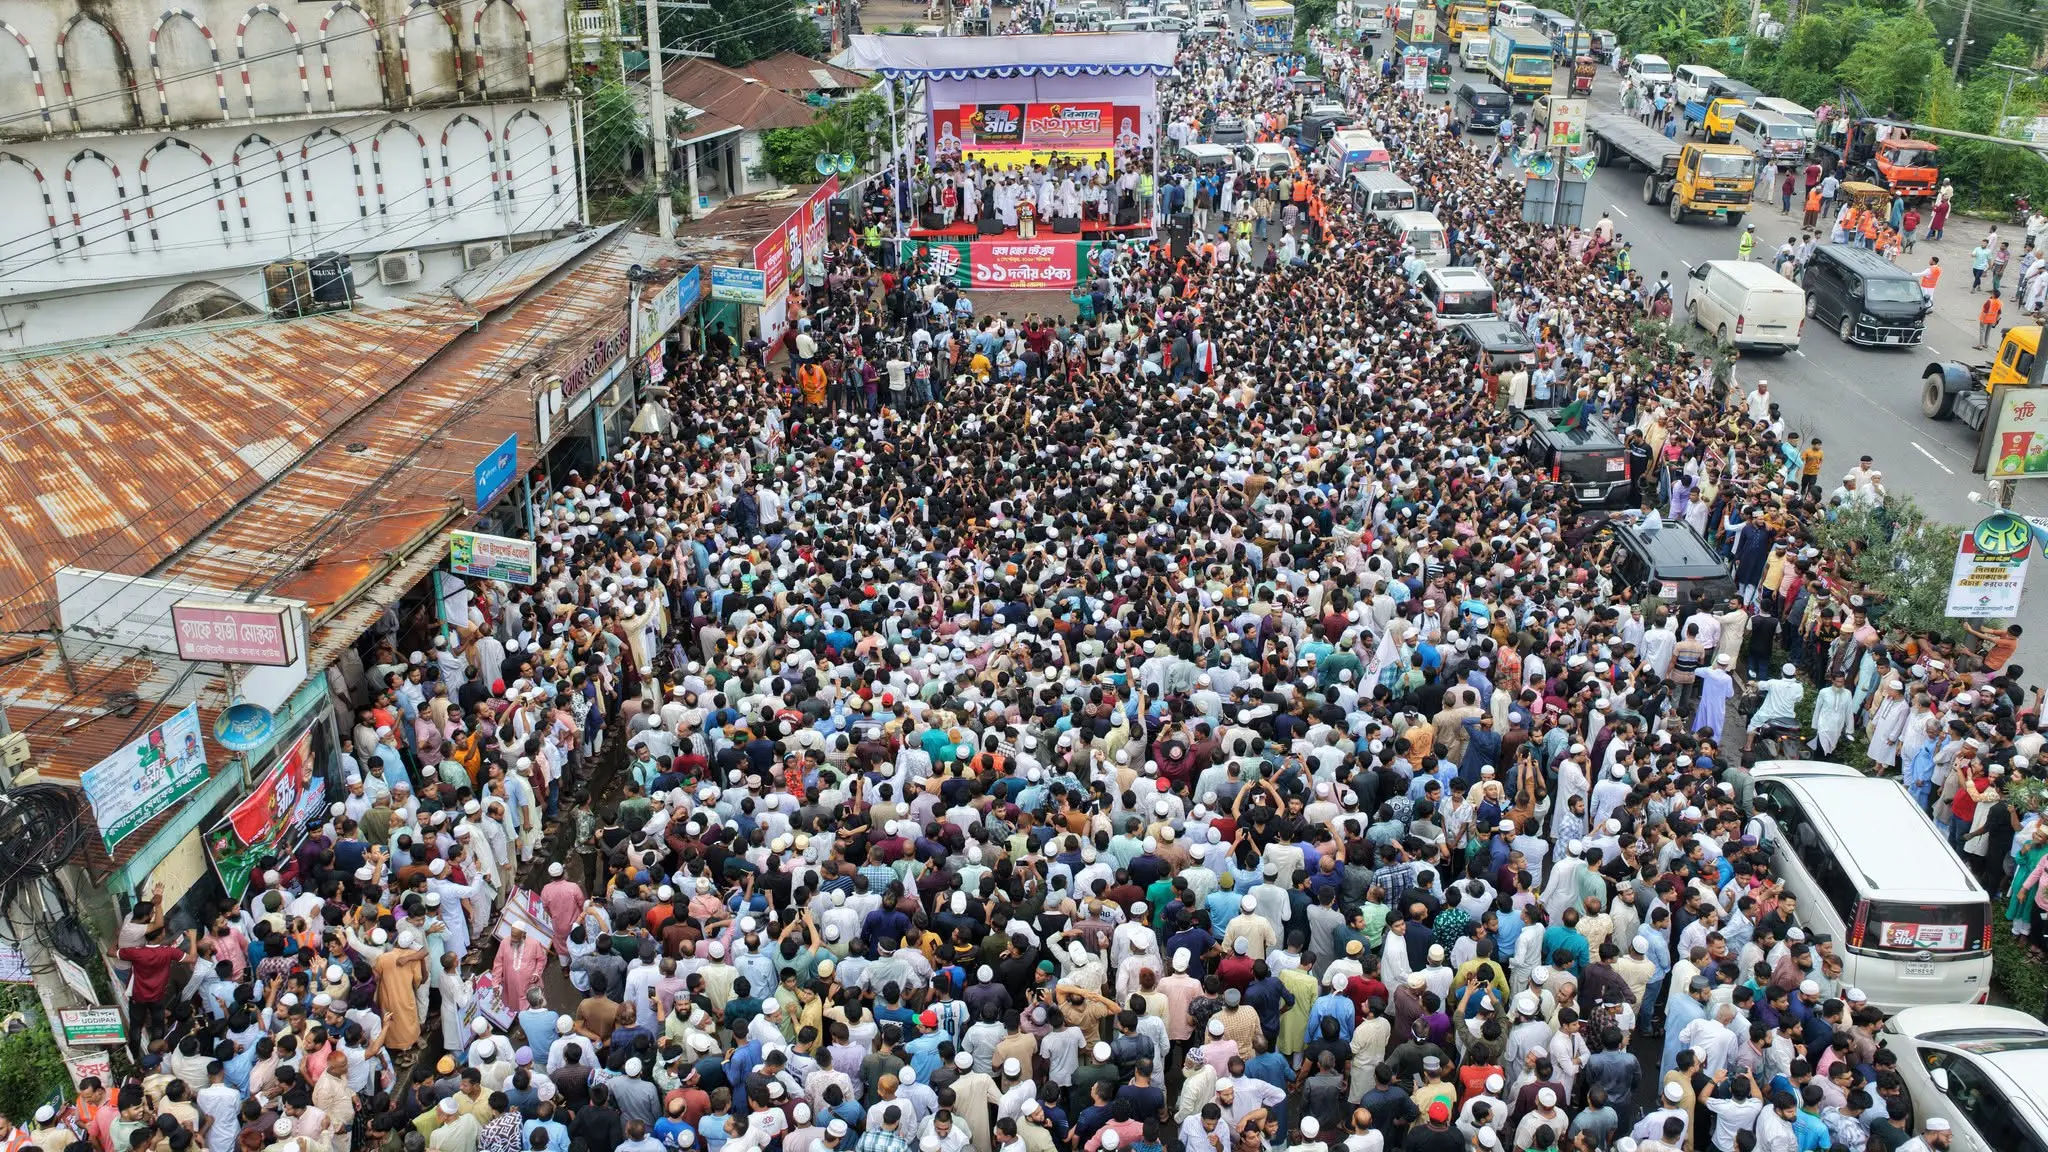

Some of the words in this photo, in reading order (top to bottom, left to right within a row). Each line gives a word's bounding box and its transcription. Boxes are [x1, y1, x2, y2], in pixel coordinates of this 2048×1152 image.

[984, 110, 1010, 121] লং
[1062, 107, 1101, 119] বিশাল
[984, 117, 1019, 133] মার্চ
[992, 246, 1009, 255] ঢাকা
[1009, 246, 1027, 256] থেকে
[977, 263, 1007, 281] ১১
[1008, 264, 1040, 281] দলীয়
[1040, 265, 1072, 280] ঐক্য
[2013, 401, 2037, 422] পুষ্টি
[1959, 578, 1982, 587] বিচার
[1983, 580, 2003, 588] করতে
[2004, 580, 2018, 589] হবে
[179, 619, 211, 641] ক্যাফে
[212, 615, 239, 642] হাজী
[240, 623, 279, 645] মোস্তফা
